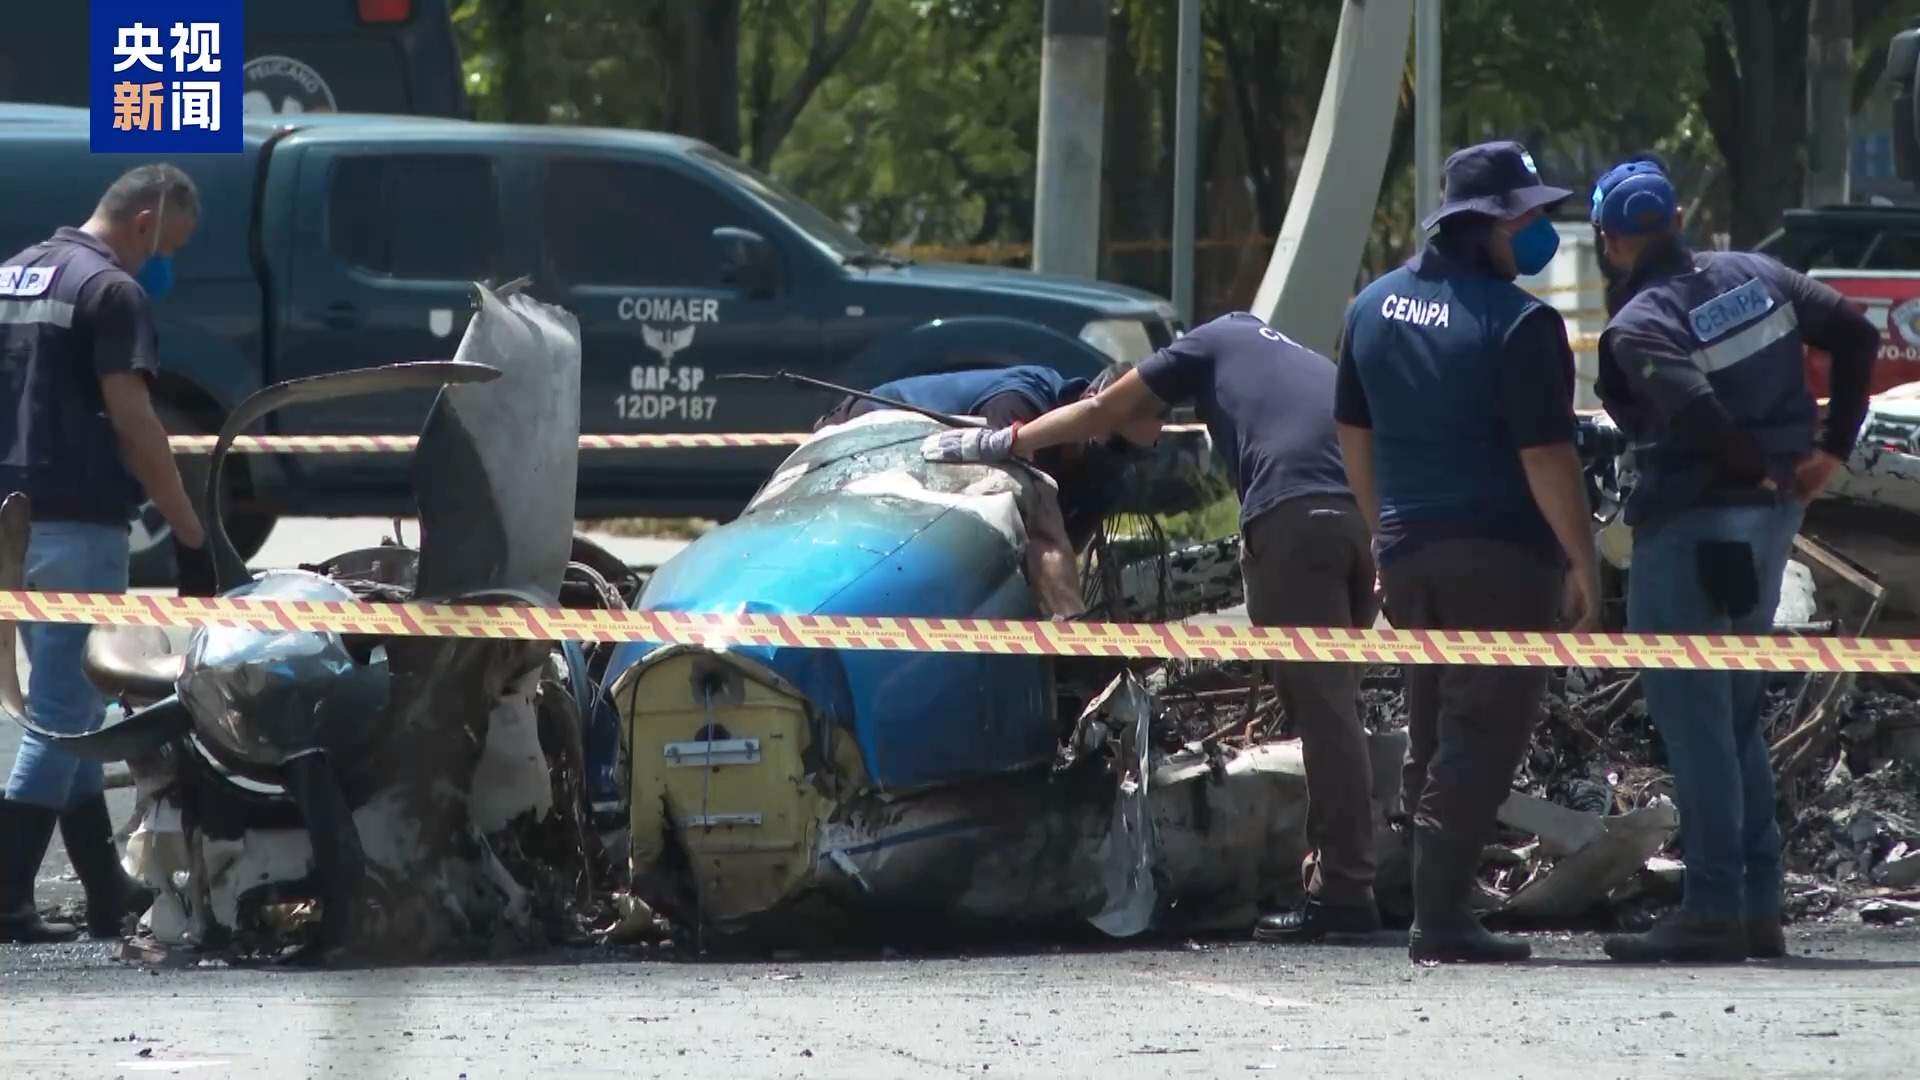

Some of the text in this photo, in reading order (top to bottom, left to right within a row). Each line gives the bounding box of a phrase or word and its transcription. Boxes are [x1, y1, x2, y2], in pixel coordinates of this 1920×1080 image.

[618, 297, 719, 322] COMAER
[1382, 294, 1449, 328] CENIPA
[631, 366, 704, 391] GAP-SP
[615, 395, 717, 420] 12DP187
